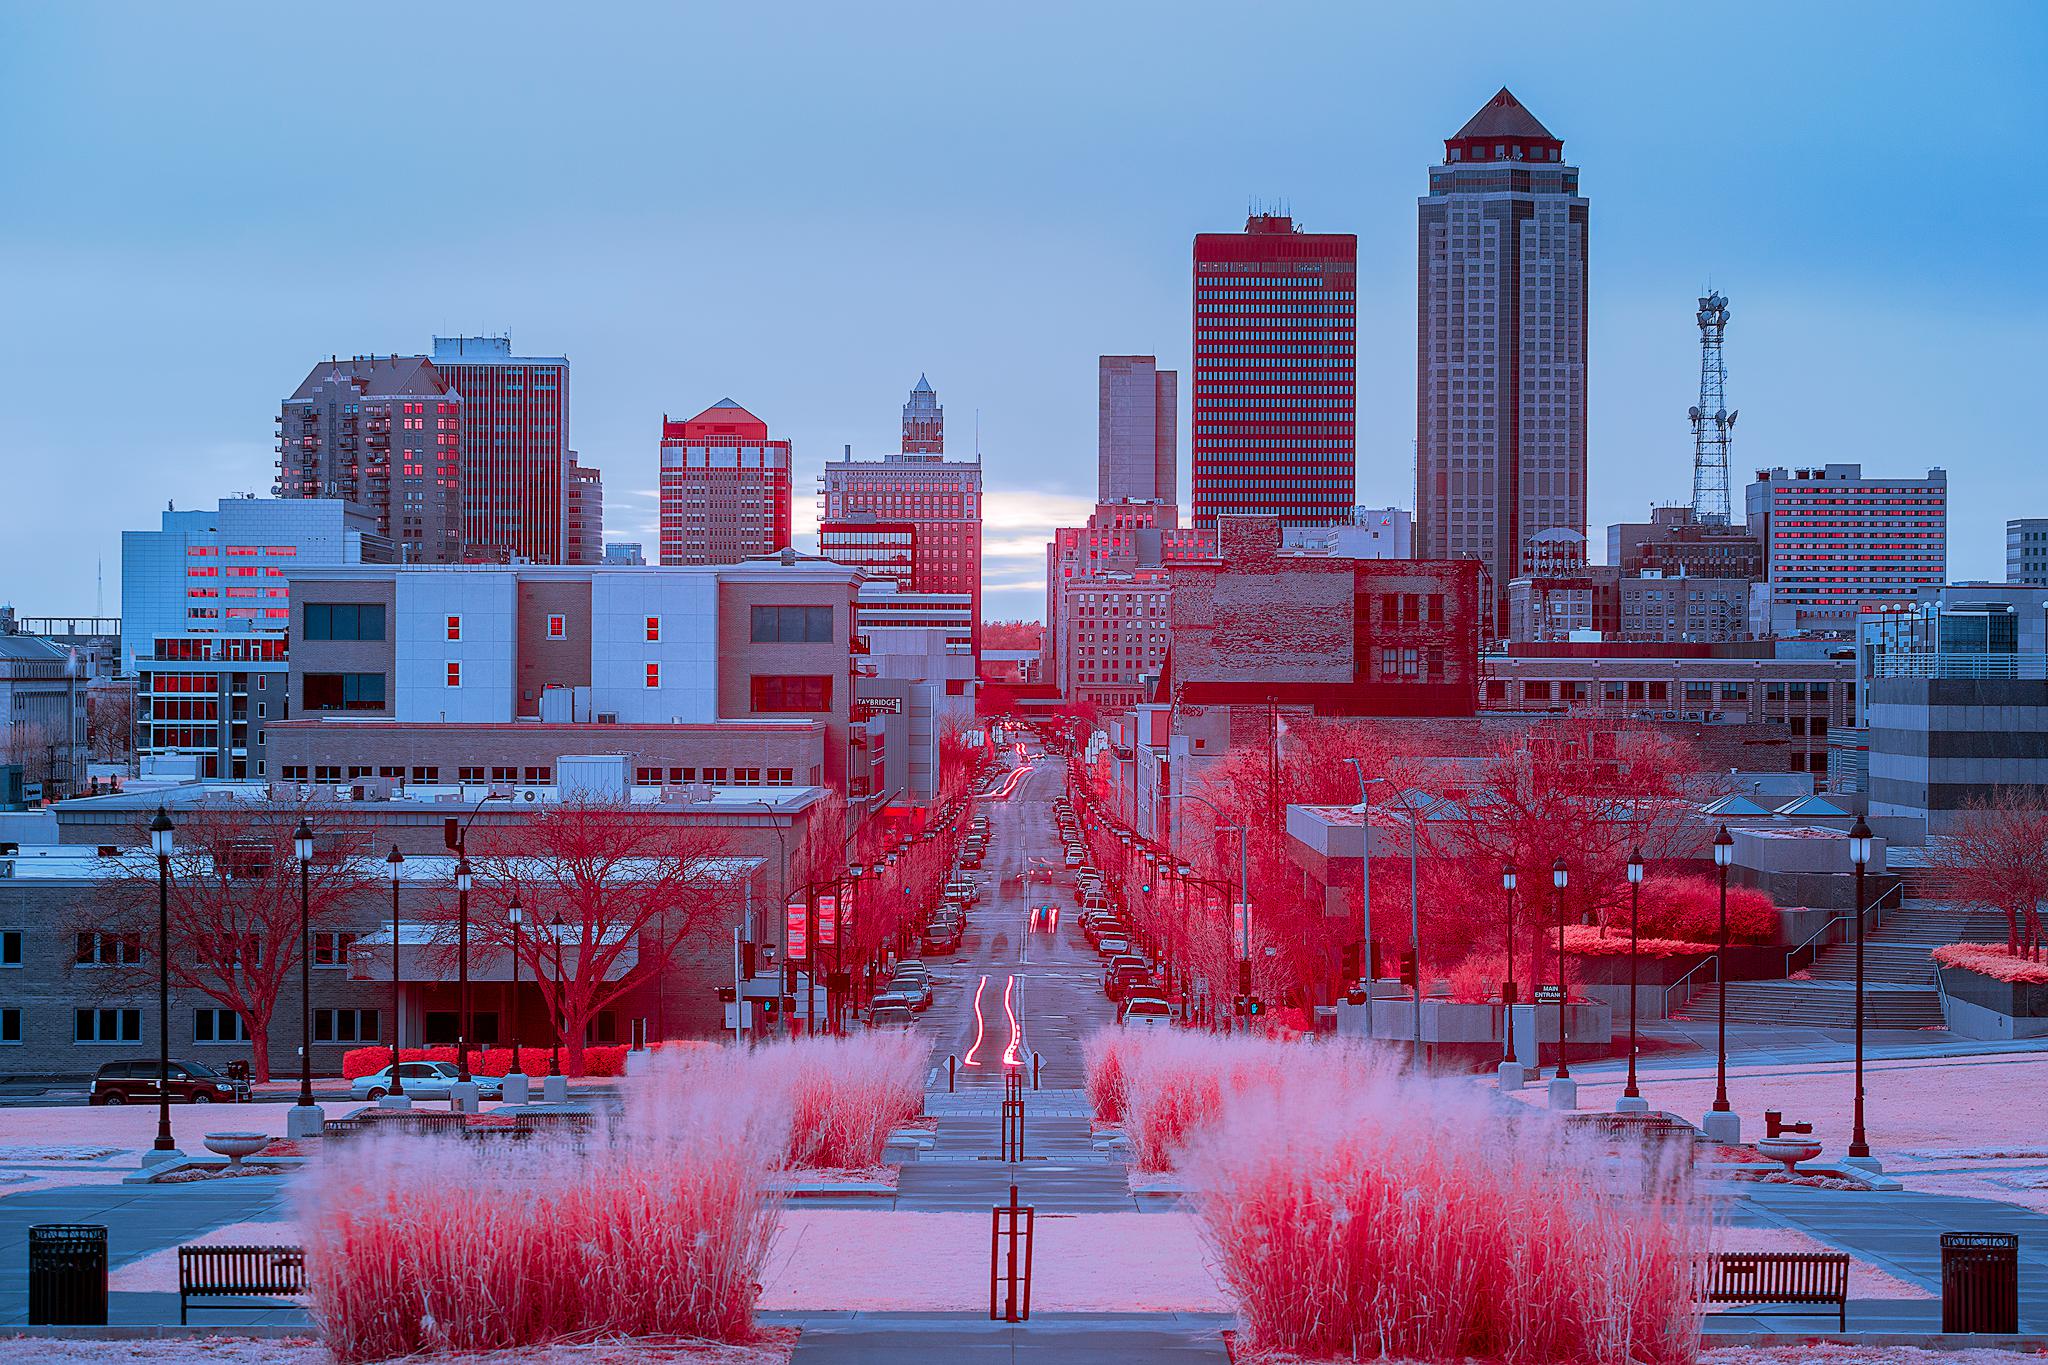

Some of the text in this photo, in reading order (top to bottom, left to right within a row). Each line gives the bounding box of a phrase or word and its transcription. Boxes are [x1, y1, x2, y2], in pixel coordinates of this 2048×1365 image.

[1527, 547, 1547, 557] THE
[1527, 558, 1591, 569] TRAVELERS
[857, 698, 896, 707] TAYBRIDGE
